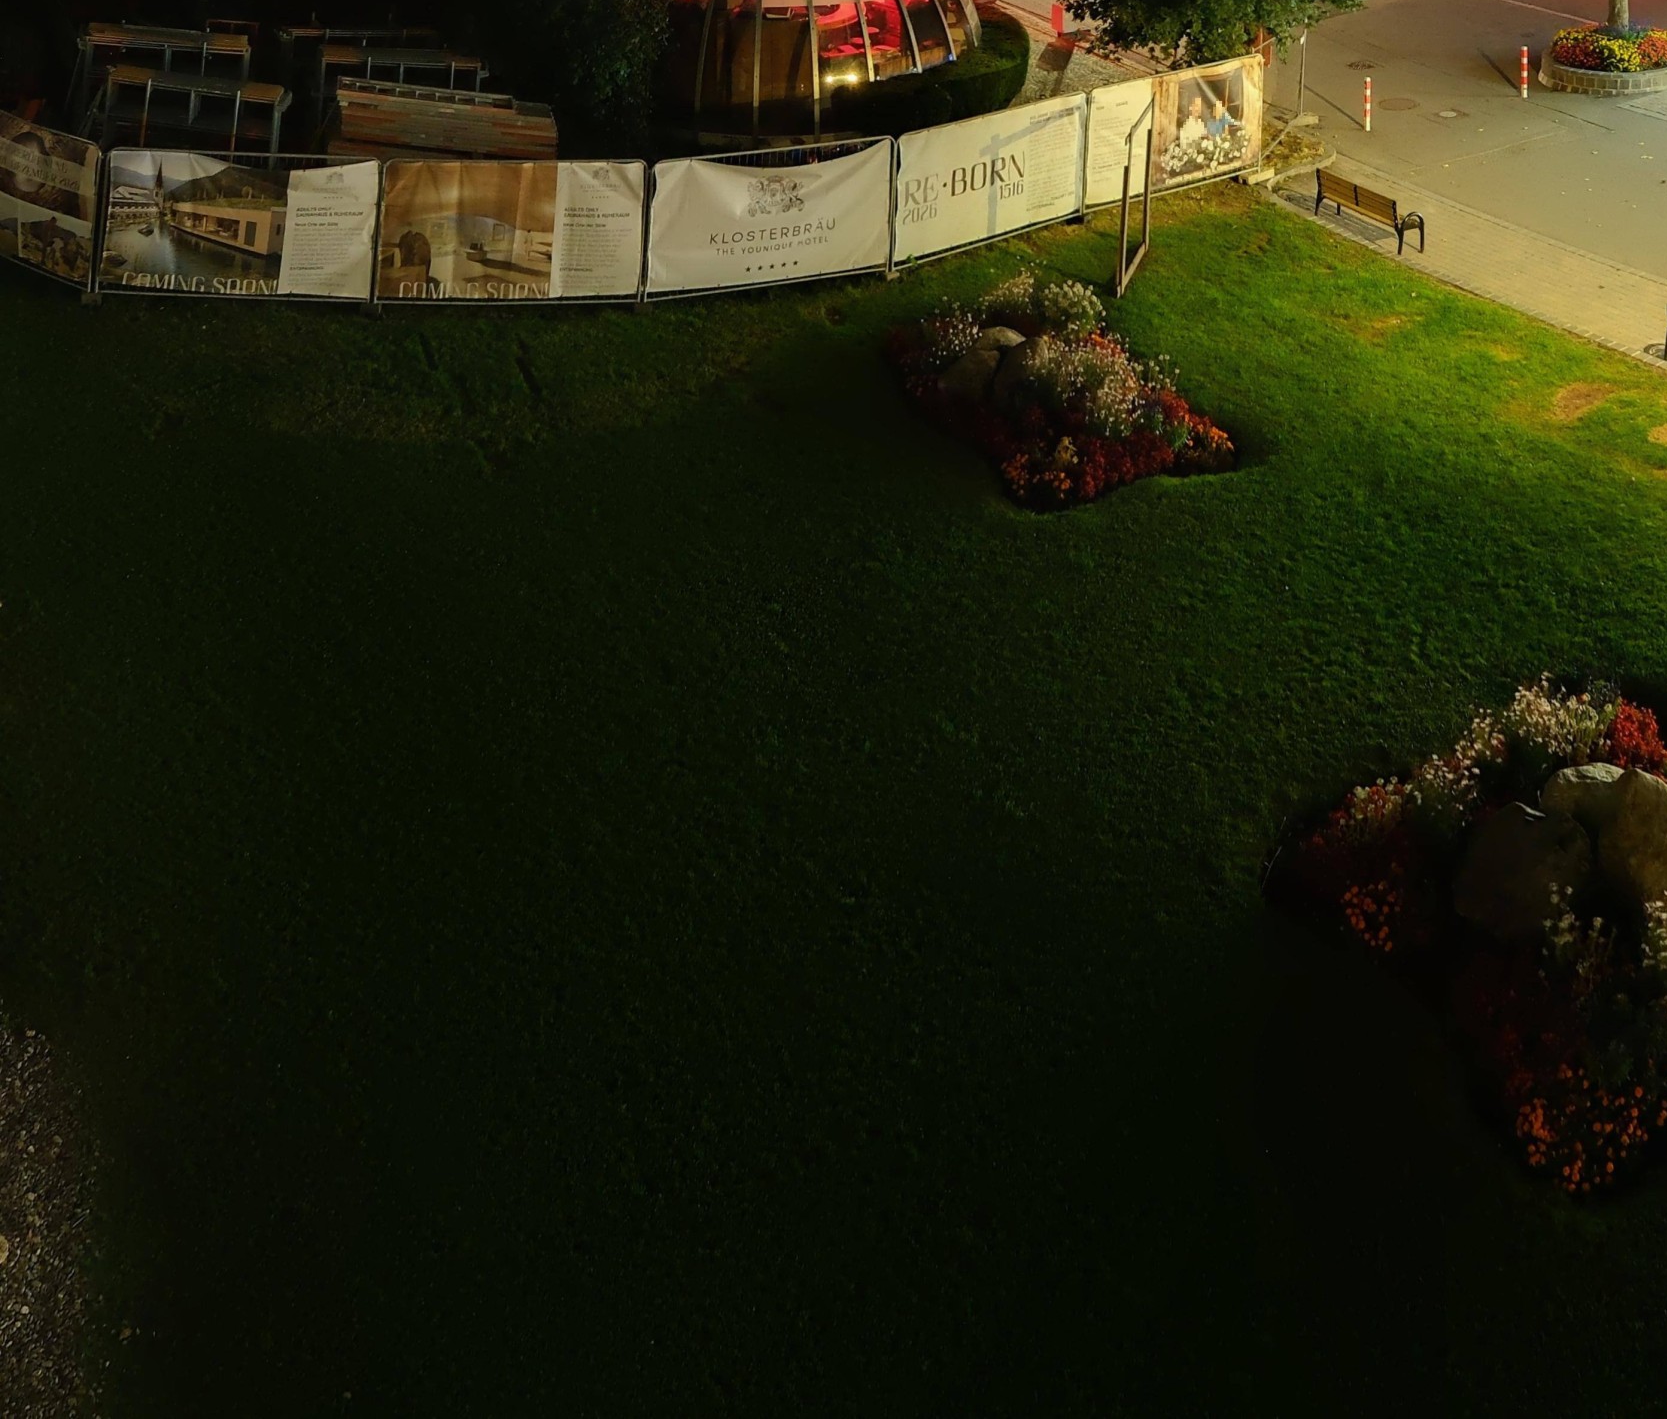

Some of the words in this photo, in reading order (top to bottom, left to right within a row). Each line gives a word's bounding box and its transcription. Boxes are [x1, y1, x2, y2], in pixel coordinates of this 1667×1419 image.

[902, 202, 938, 226] 2026
[709, 217, 836, 245] KLOSTERBRÄU
[716, 247, 736, 256] THE
[741, 241, 793, 255] YOUNIQUE
[797, 235, 829, 247] HOTEL
